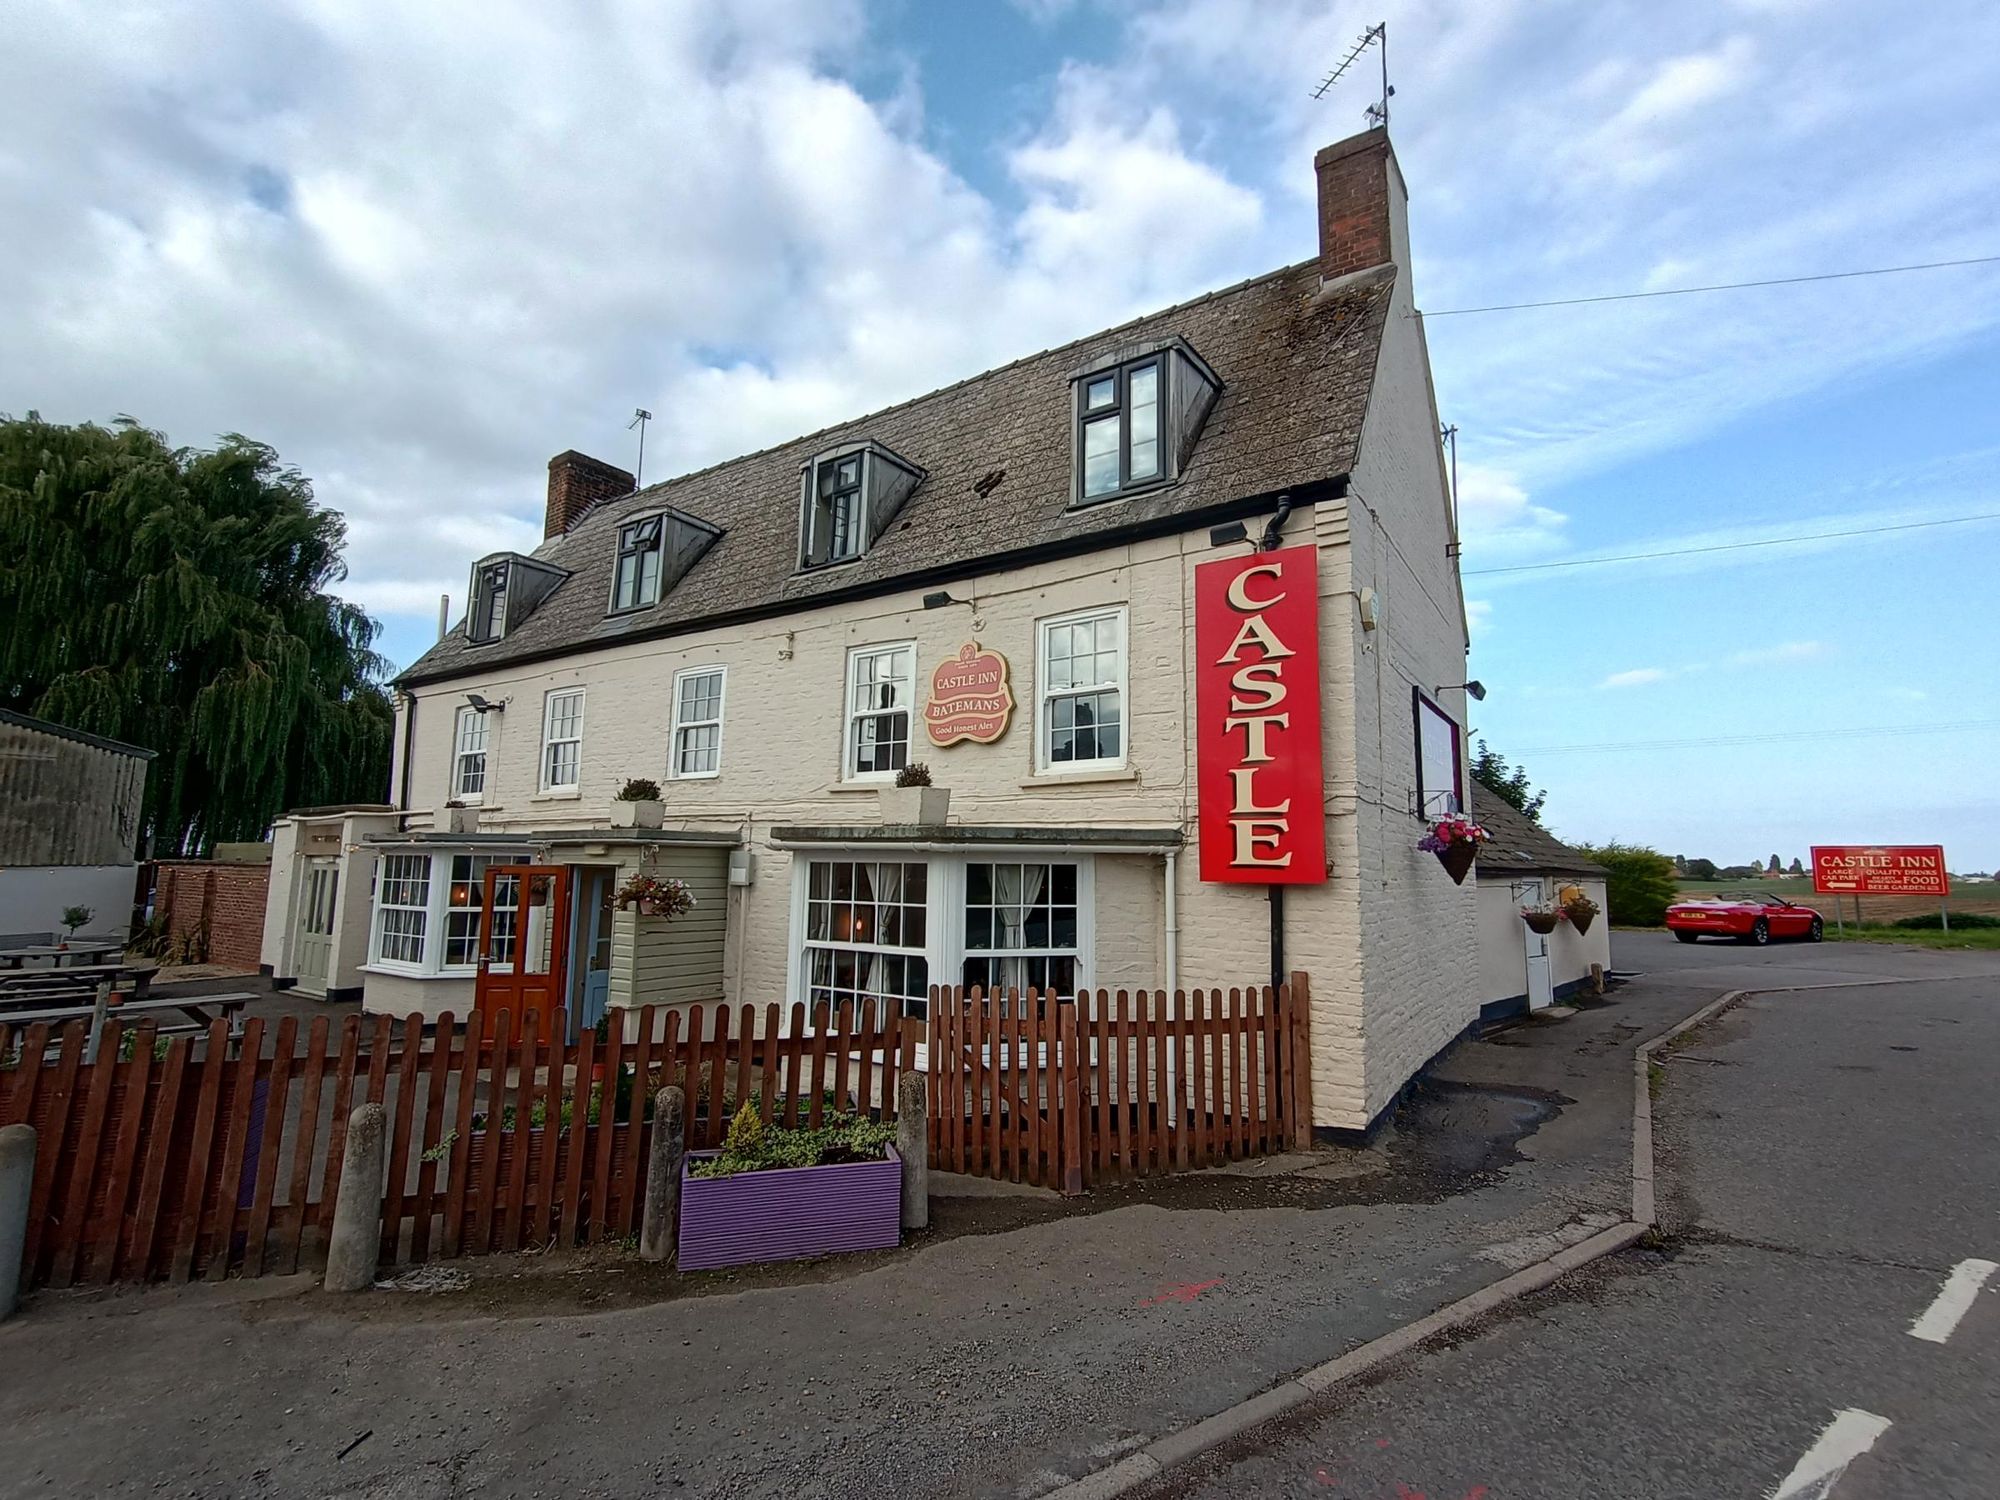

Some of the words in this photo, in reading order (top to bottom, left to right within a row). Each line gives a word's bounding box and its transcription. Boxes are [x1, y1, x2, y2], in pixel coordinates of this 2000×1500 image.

[937, 674, 975, 689] CASTLE
[978, 671, 998, 684] INN
[932, 699, 1000, 717] BATEMANS
[1214, 562, 1297, 868] CASTLE
[935, 725, 953, 735] Good
[953, 724, 977, 733] Honest
[978, 722, 993, 730] Ales
[1820, 856, 1893, 867] CASTLE
[1899, 856, 1935, 867] INN
[1902, 876, 1940, 885] FOOD
